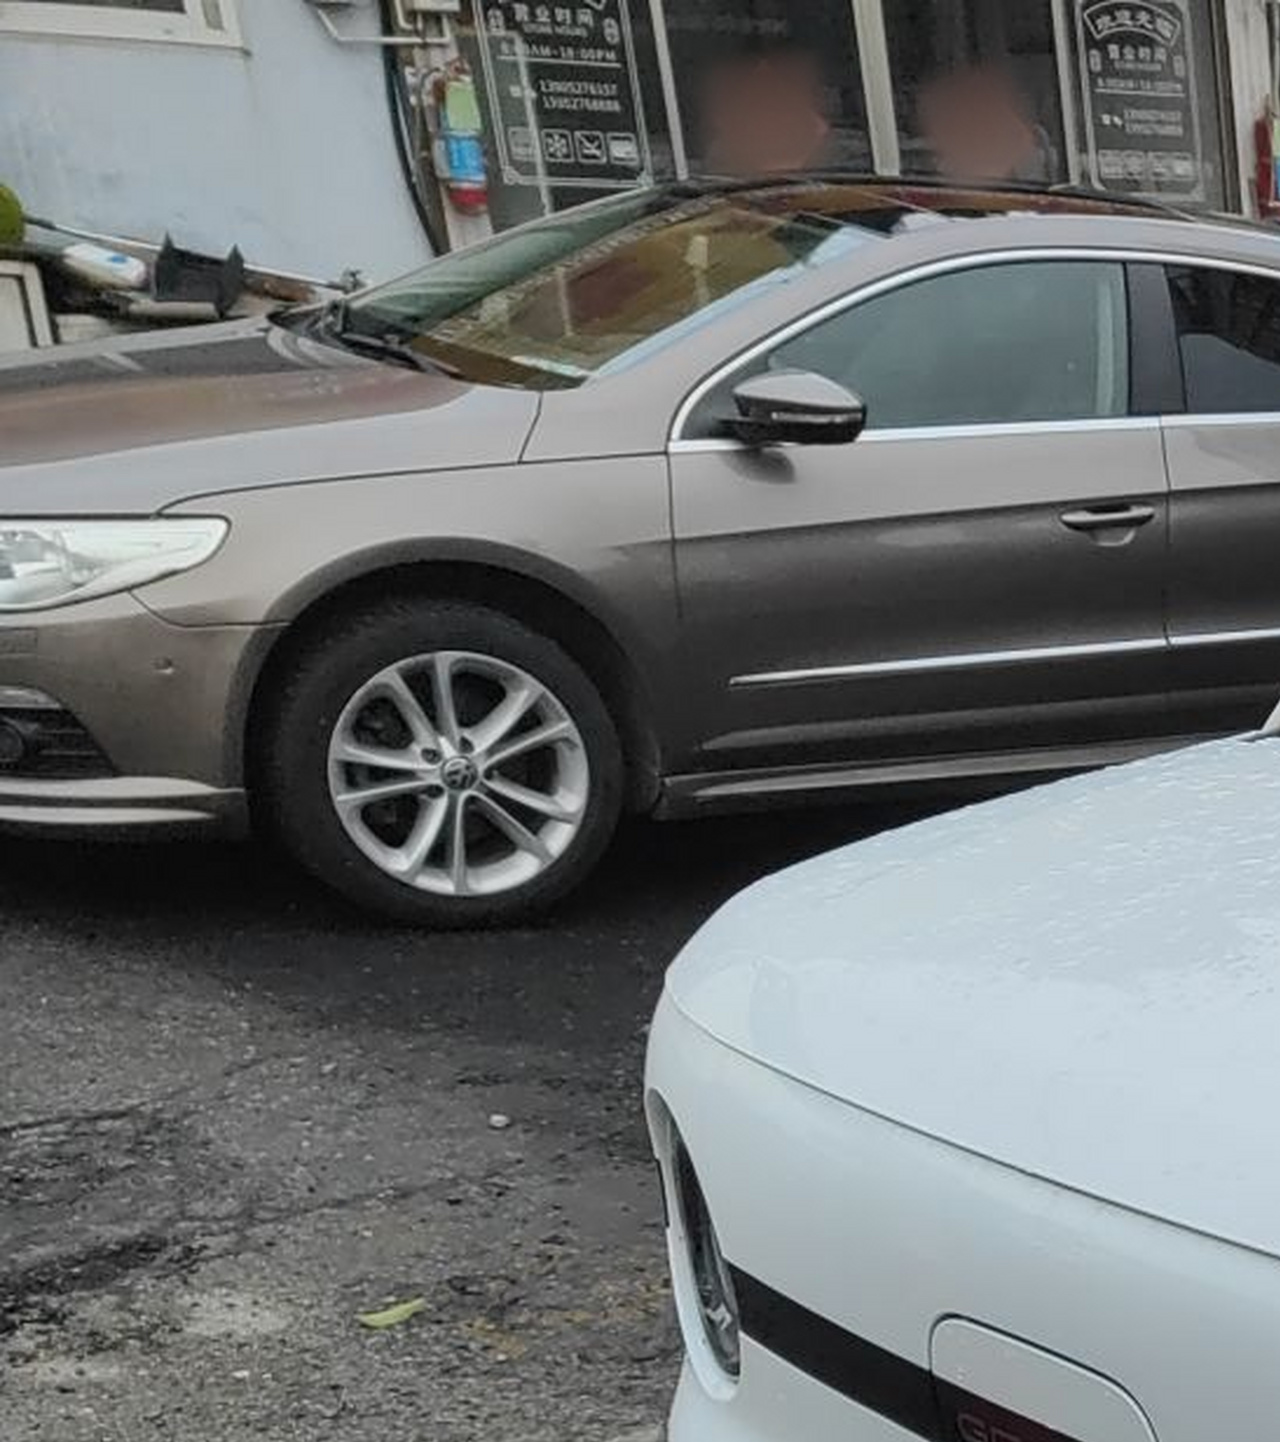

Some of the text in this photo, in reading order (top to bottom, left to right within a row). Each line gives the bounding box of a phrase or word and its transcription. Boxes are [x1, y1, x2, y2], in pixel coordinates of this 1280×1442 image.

[513, 3, 594, 27] 营业时间
[1107, 43, 1167, 63] 营业时间
